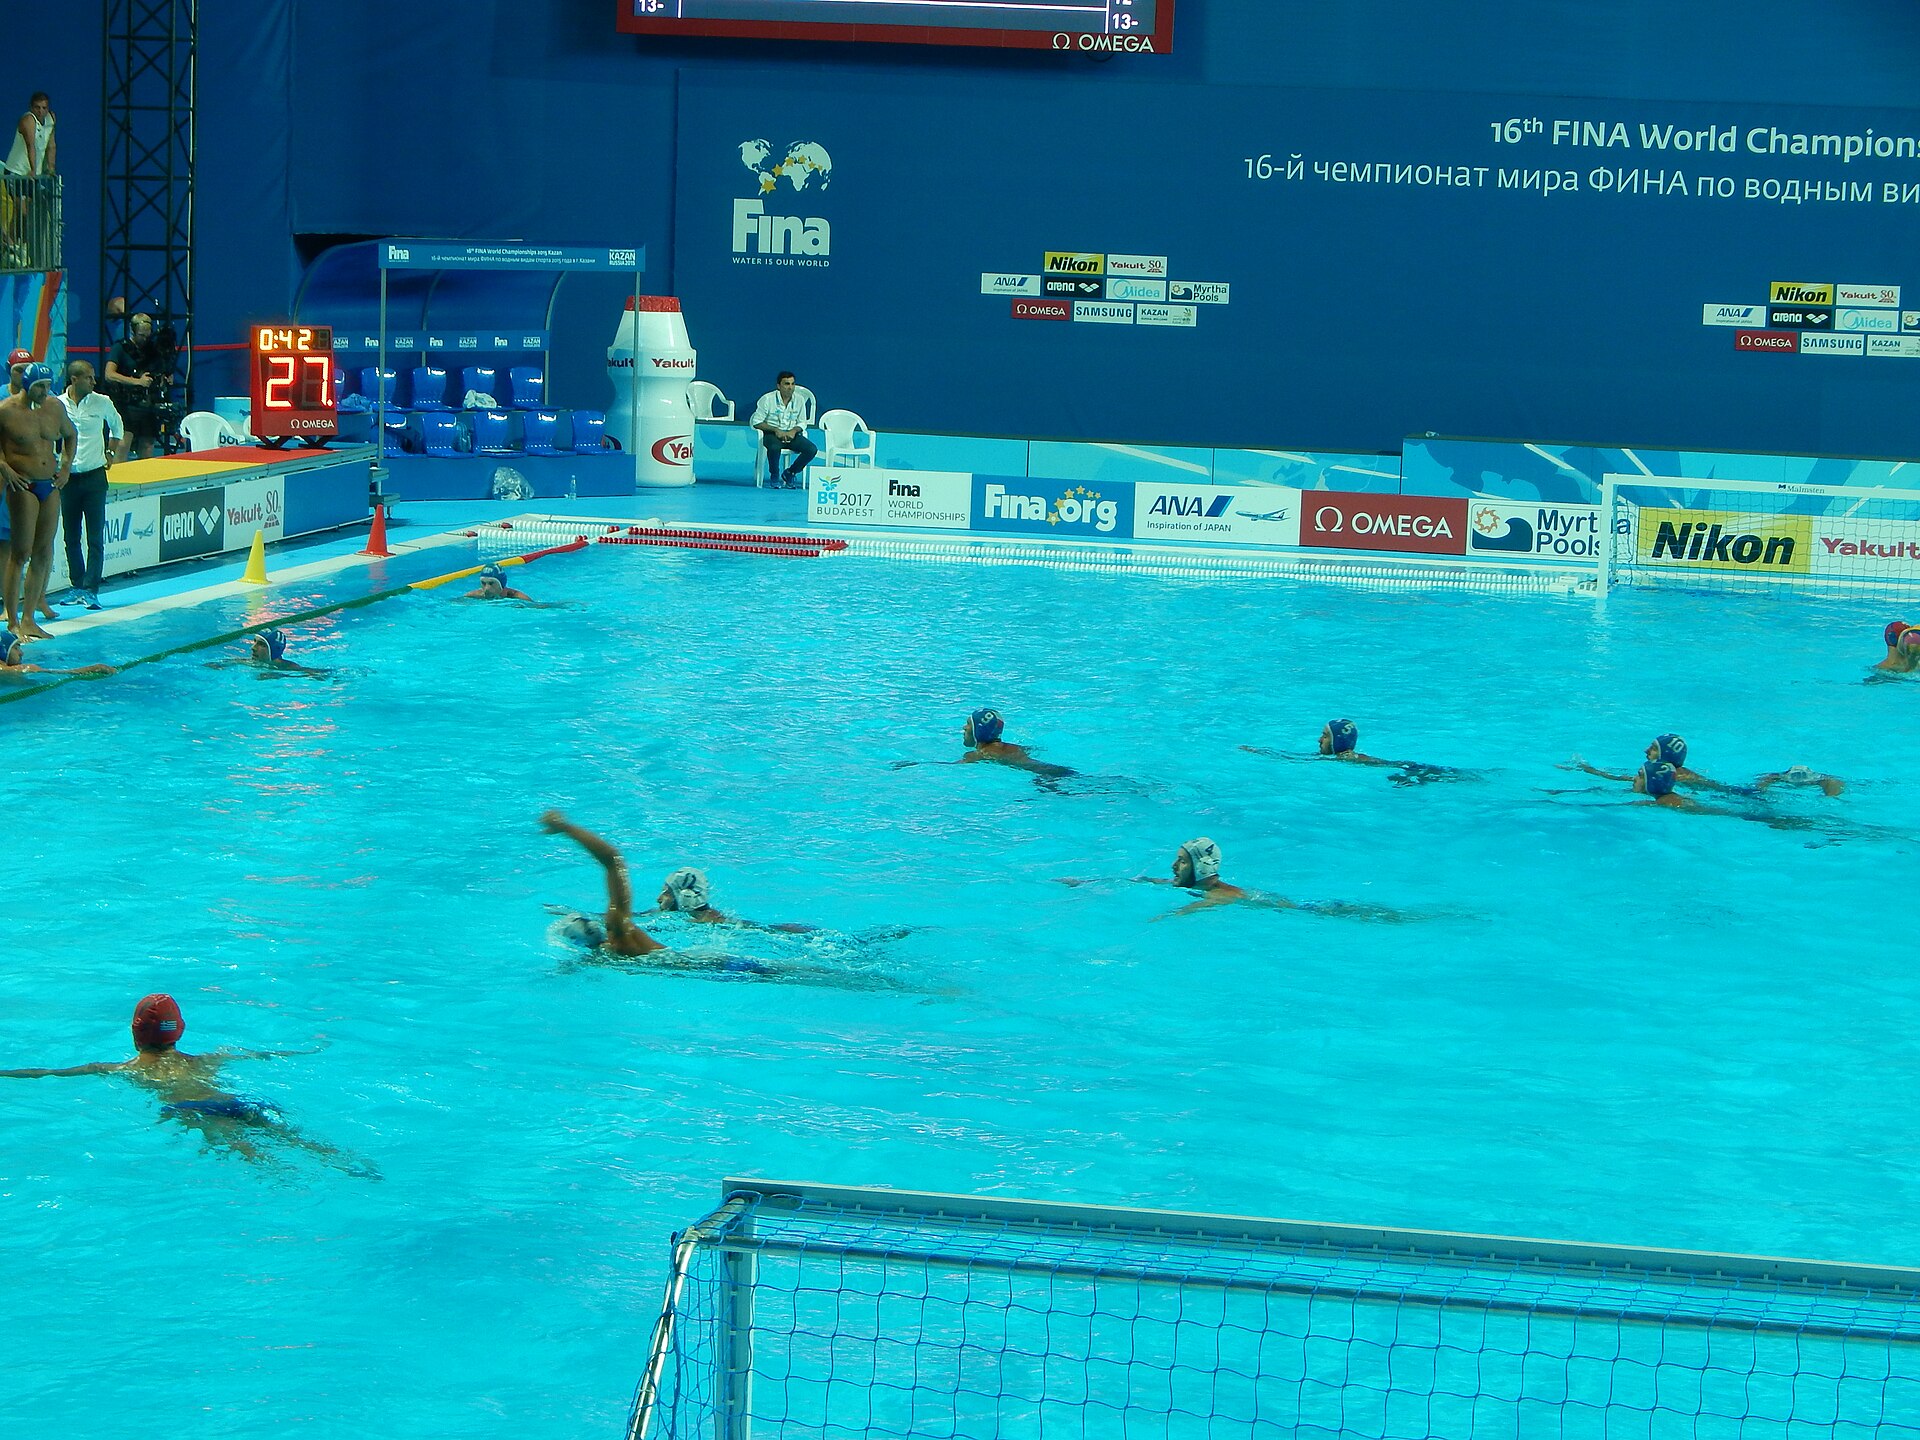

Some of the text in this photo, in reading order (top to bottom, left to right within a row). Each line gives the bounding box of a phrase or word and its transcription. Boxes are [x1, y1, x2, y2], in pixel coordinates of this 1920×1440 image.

[1112, 13, 1139, 30] 13-
[1078, 34, 1154, 53] OMEGA
[1490, 117, 1920, 163] 16th FINA World Champion
[1244, 153, 1920, 205] 16-й чемпионат мира ФИНА по водным ви
[732, 198, 831, 256] Fina
[388, 245, 409, 259] Fina
[609, 252, 635, 260] KAZAN
[732, 257, 762, 265] WATER
[765, 258, 773, 266] IS
[797, 259, 830, 267] WORLD
[1049, 256, 1098, 272] Nikon
[1110, 261, 1146, 270] Yakult
[994, 276, 1017, 287] ANA
[1046, 281, 1075, 292] arena
[1121, 284, 1160, 298] Midea
[1193, 283, 1227, 294] Myrtha
[1776, 286, 1828, 303] Nikon
[1193, 292, 1219, 302] Pools
[1840, 291, 1877, 300] Yakult
[1030, 305, 1066, 316] OMEGA
[1075, 306, 1132, 318] SAMSUNG
[1141, 308, 1168, 316] KAZAN
[1716, 307, 1741, 318] ANA
[1772, 312, 1803, 323] arena
[1851, 315, 1892, 329] Midea
[260, 329, 312, 350] 0:42
[1753, 337, 1792, 348] OMEGA
[1803, 337, 1862, 349] SAMSUNG
[652, 358, 694, 368] Yakult
[302, 419, 335, 429] OMEGA
[889, 479, 920, 497] Fina
[1787, 486, 1825, 494] Malmsten
[839, 493, 872, 507] 2017
[888, 500, 924, 510] WORLD
[1148, 495, 1203, 516] ANA
[227, 503, 263, 526] Yakult
[816, 507, 874, 517] BUDAPEST
[887, 510, 966, 522] CHAMPIONSHIPS
[163, 511, 195, 542] arena
[1146, 521, 1232, 532] Inspiration of JAPAN
[1351, 513, 1453, 539] OMEGA
[1537, 508, 1631, 537] Myrta
[103, 518, 120, 545] NA
[1651, 520, 1796, 566] Nikon
[1820, 537, 1920, 560] Yakult
[1666, 737, 1684, 753] 10
[1656, 764, 1670, 777] 2
[1205, 844, 1214, 856] 4
